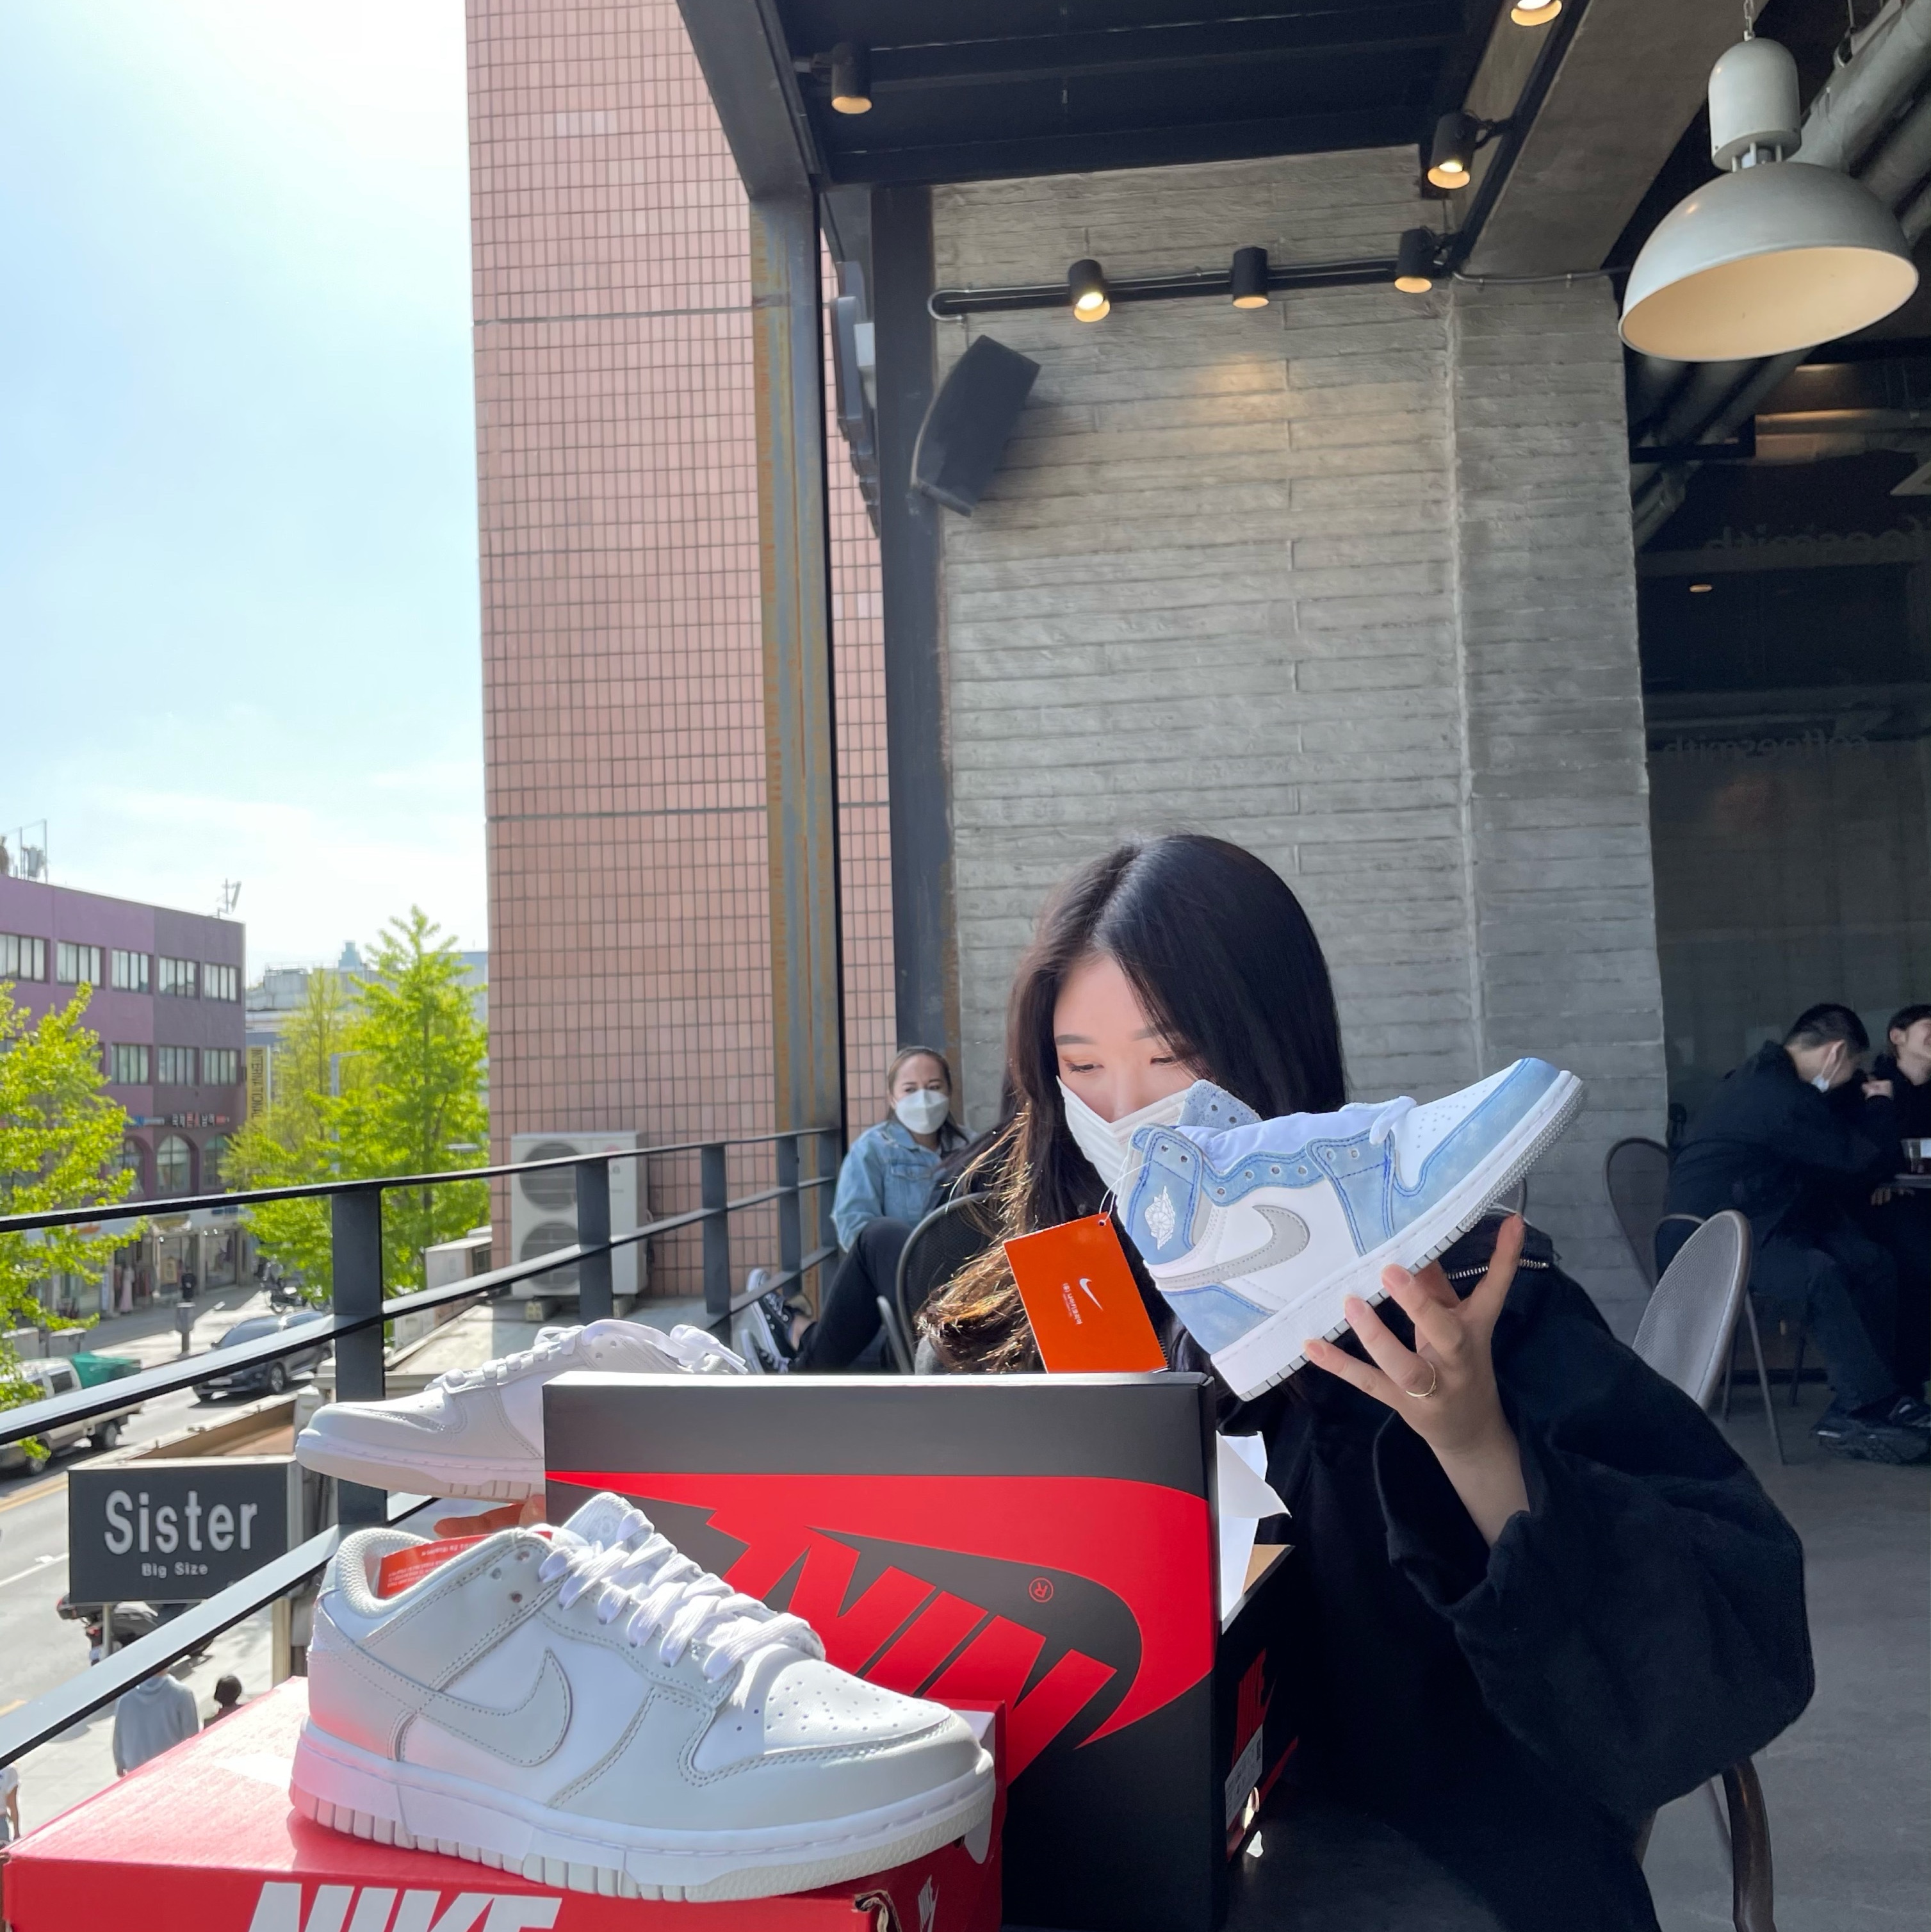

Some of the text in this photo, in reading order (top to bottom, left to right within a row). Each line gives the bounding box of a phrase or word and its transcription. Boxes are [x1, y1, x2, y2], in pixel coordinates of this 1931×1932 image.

[250, 1047, 263, 1120] INTERNATIONAL
[104, 1489, 257, 1555] Sister
[141, 1561, 209, 1579] Big Size
